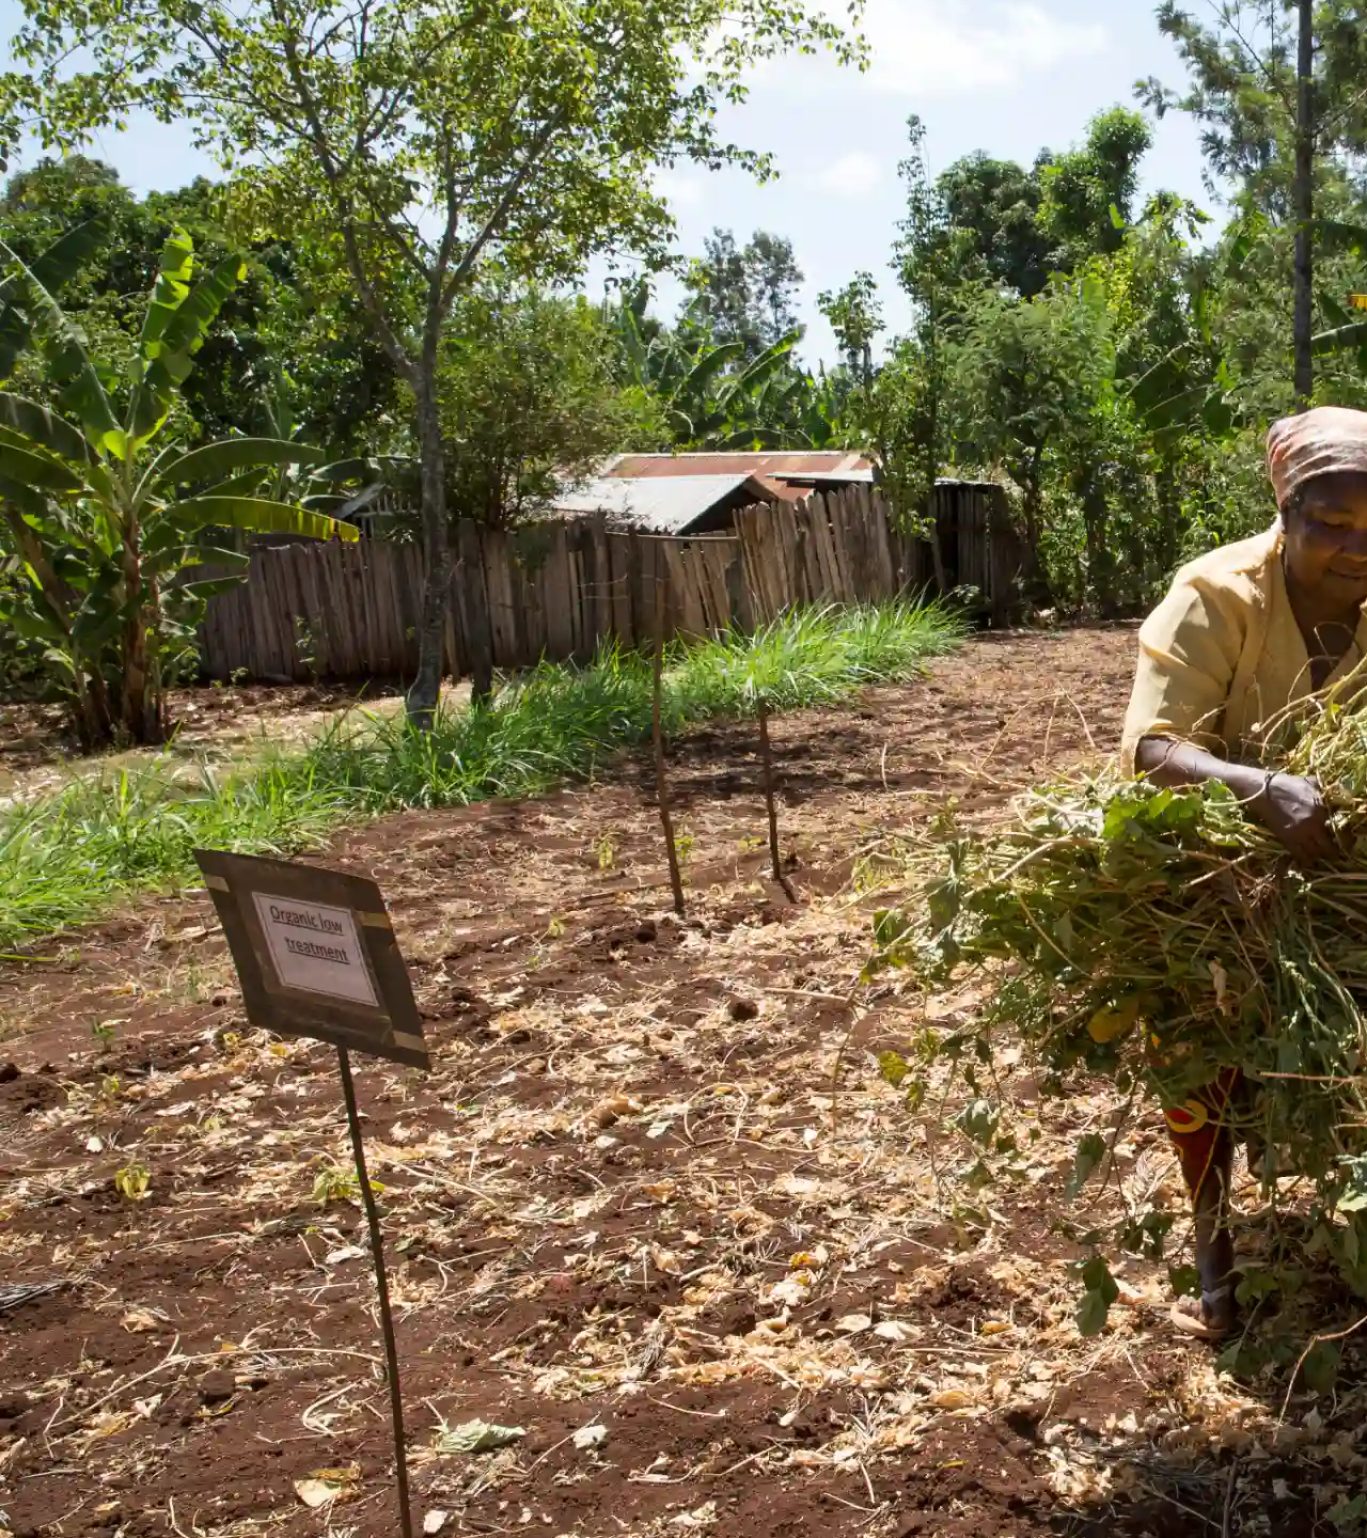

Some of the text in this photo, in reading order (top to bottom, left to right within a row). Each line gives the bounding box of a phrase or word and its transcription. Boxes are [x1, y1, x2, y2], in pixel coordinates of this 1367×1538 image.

[269, 905, 343, 933] Organic low
[284, 936, 349, 962] treatment
